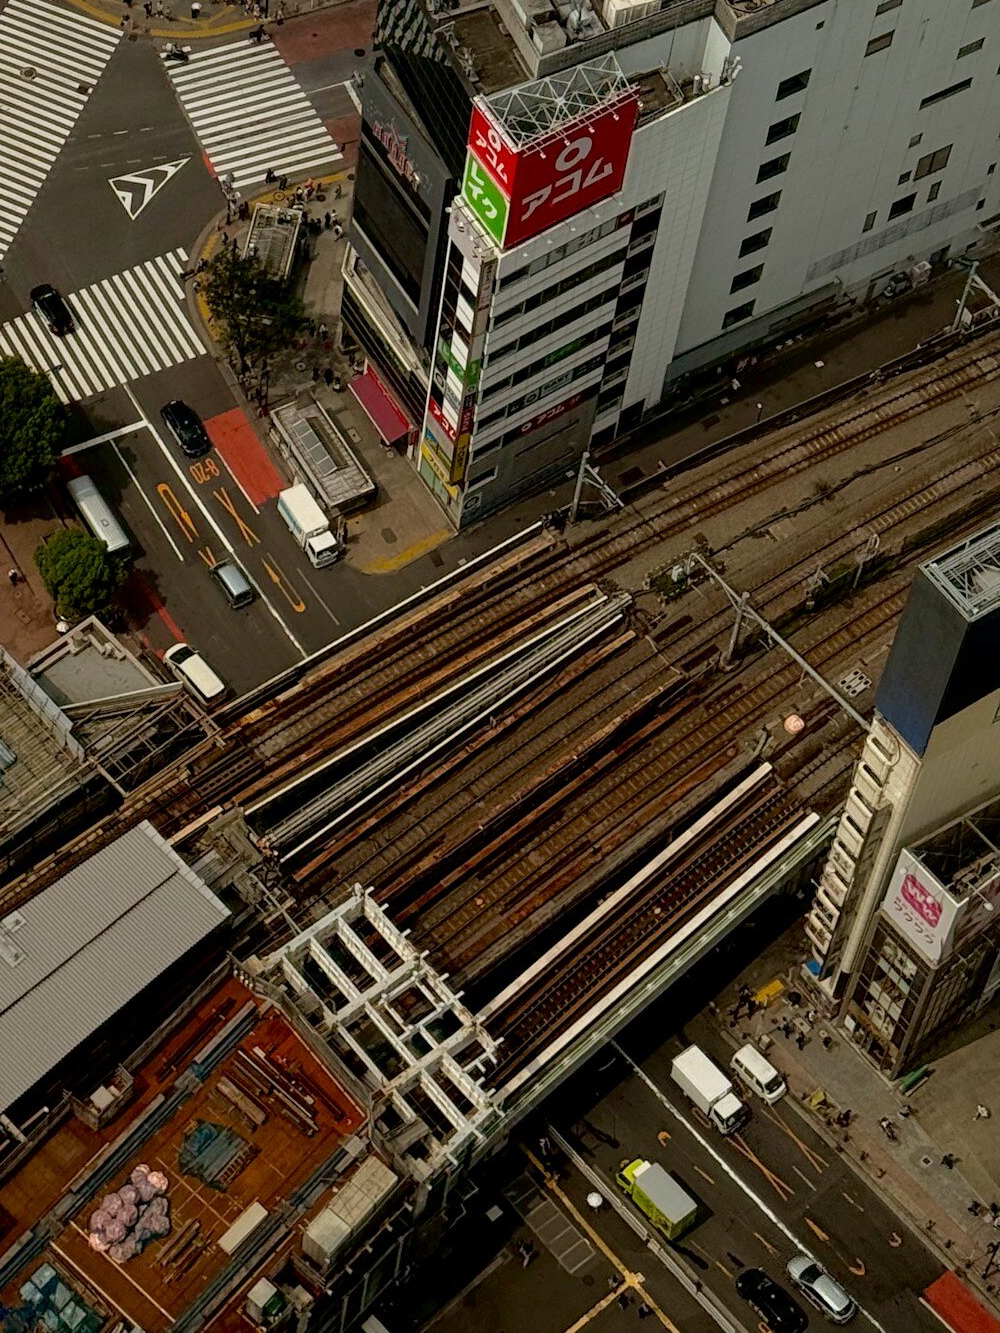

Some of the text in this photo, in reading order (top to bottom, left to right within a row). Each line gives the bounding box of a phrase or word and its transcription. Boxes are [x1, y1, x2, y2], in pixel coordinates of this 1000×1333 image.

[475, 129, 508, 185] アコム
[468, 160, 498, 219] レイク
[521, 157, 614, 222] アコム
